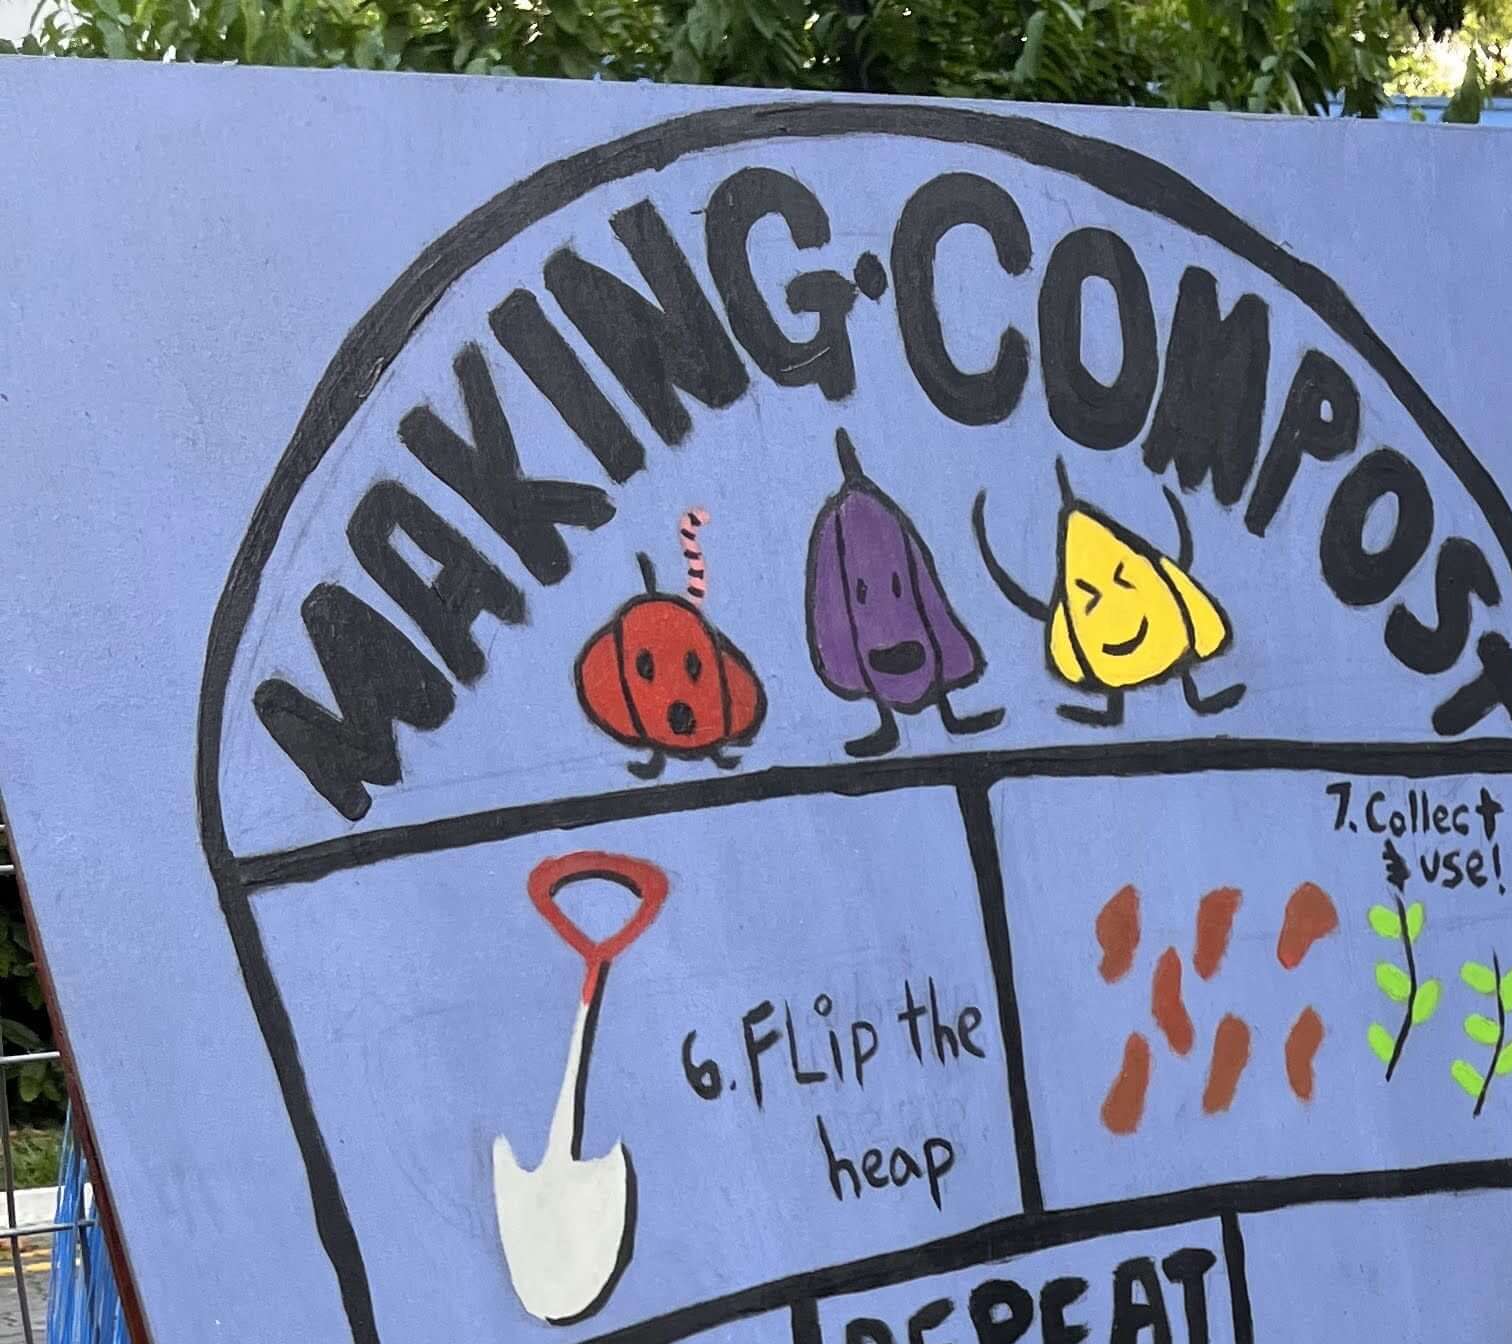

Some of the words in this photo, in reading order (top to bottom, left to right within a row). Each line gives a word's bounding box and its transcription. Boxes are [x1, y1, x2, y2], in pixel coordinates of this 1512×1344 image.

[253, 166, 857, 821] MAKING
[898, 976, 986, 1067] the
[817, 1114, 956, 1211] heap
